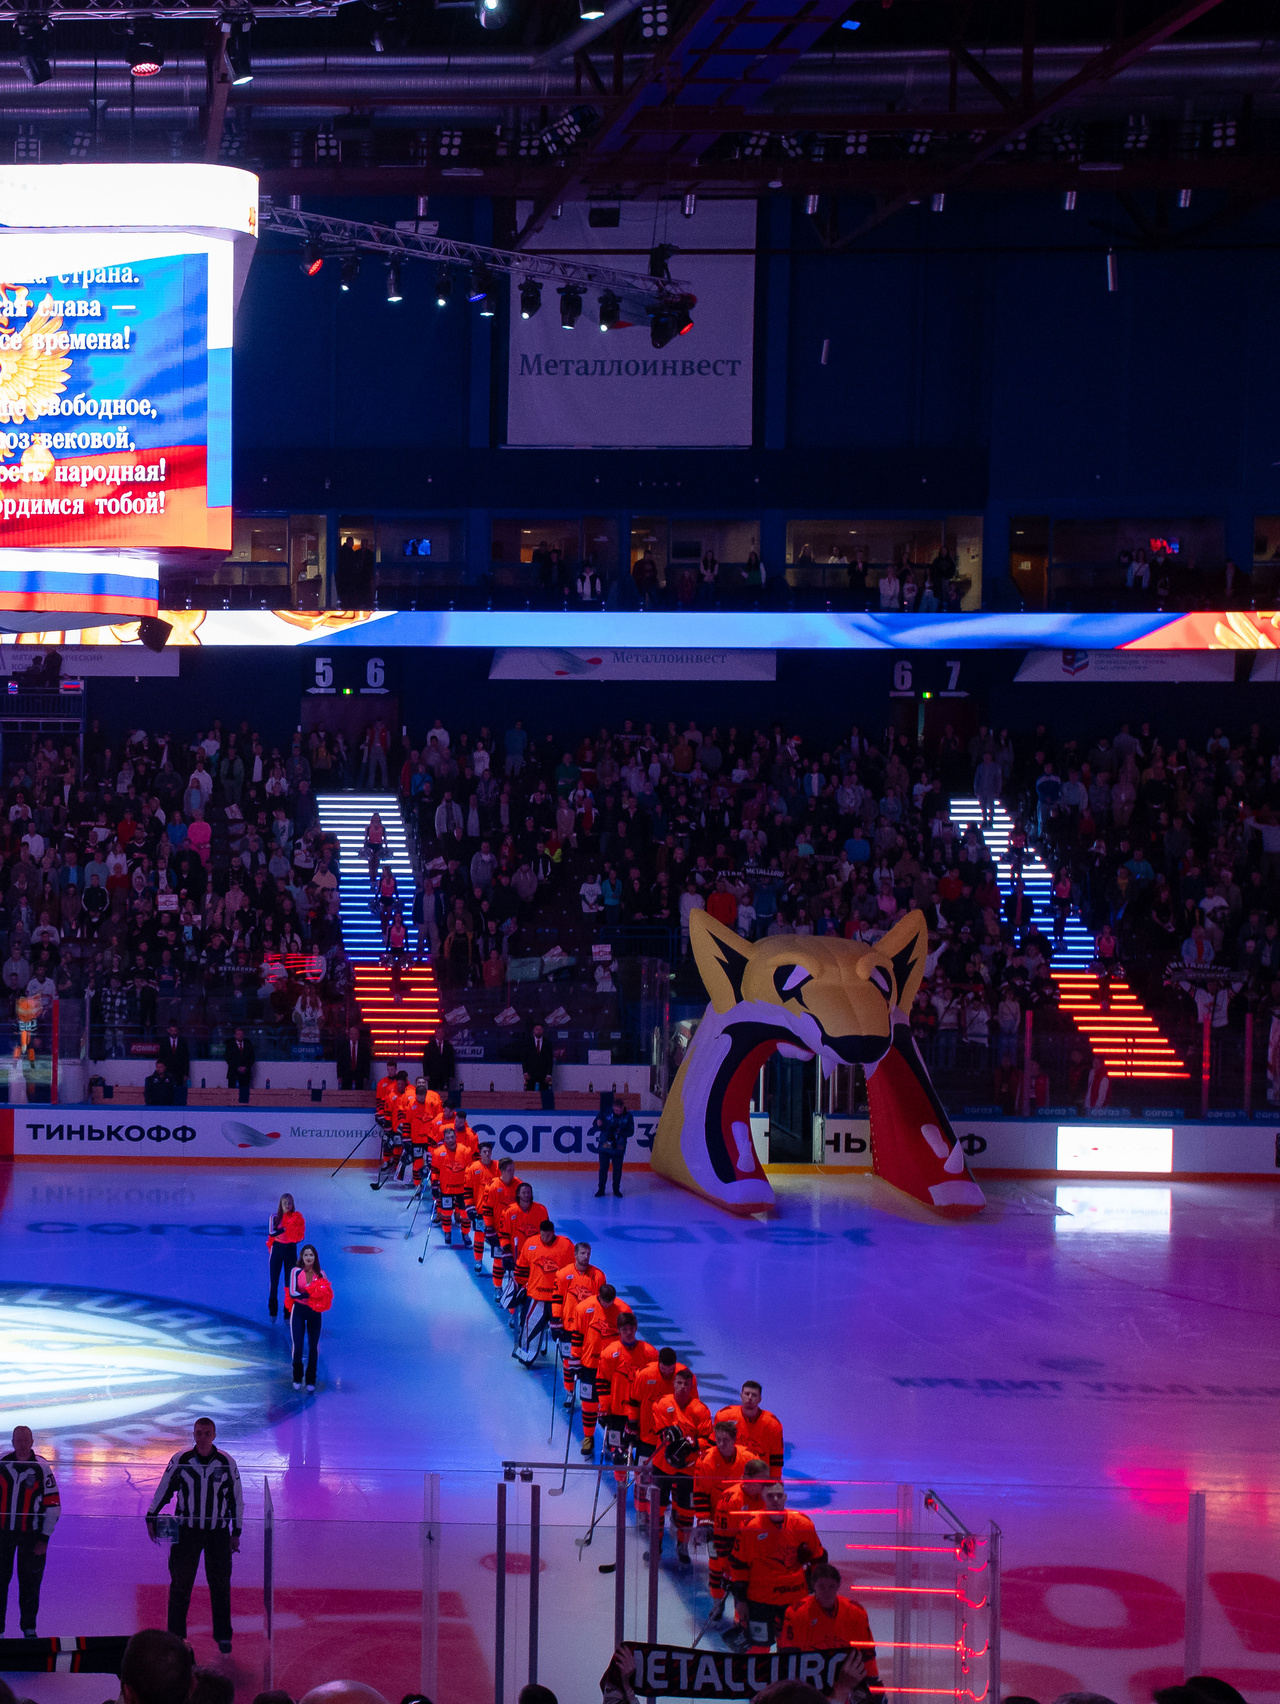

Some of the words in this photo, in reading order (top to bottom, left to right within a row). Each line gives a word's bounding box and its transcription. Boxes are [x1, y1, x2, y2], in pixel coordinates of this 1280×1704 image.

[38, 300, 102, 318] слава
[32, 325, 131, 356] времена!
[519, 353, 742, 377] Металлоинвест
[37, 392, 158, 419] свободное,
[40, 425, 136, 453] вековой,
[54, 456, 167, 487] народная!
[94, 490, 166, 516] тобой!
[612, 651, 728, 664] Металлоинвест
[314, 657, 334, 688] 5
[366, 657, 386, 688] 6
[893, 659, 913, 691] 6
[945, 660, 962, 691] 7
[26, 1123, 197, 1143] ТИНЬКОФФ
[289, 1126, 385, 1140] Металлоинвес
